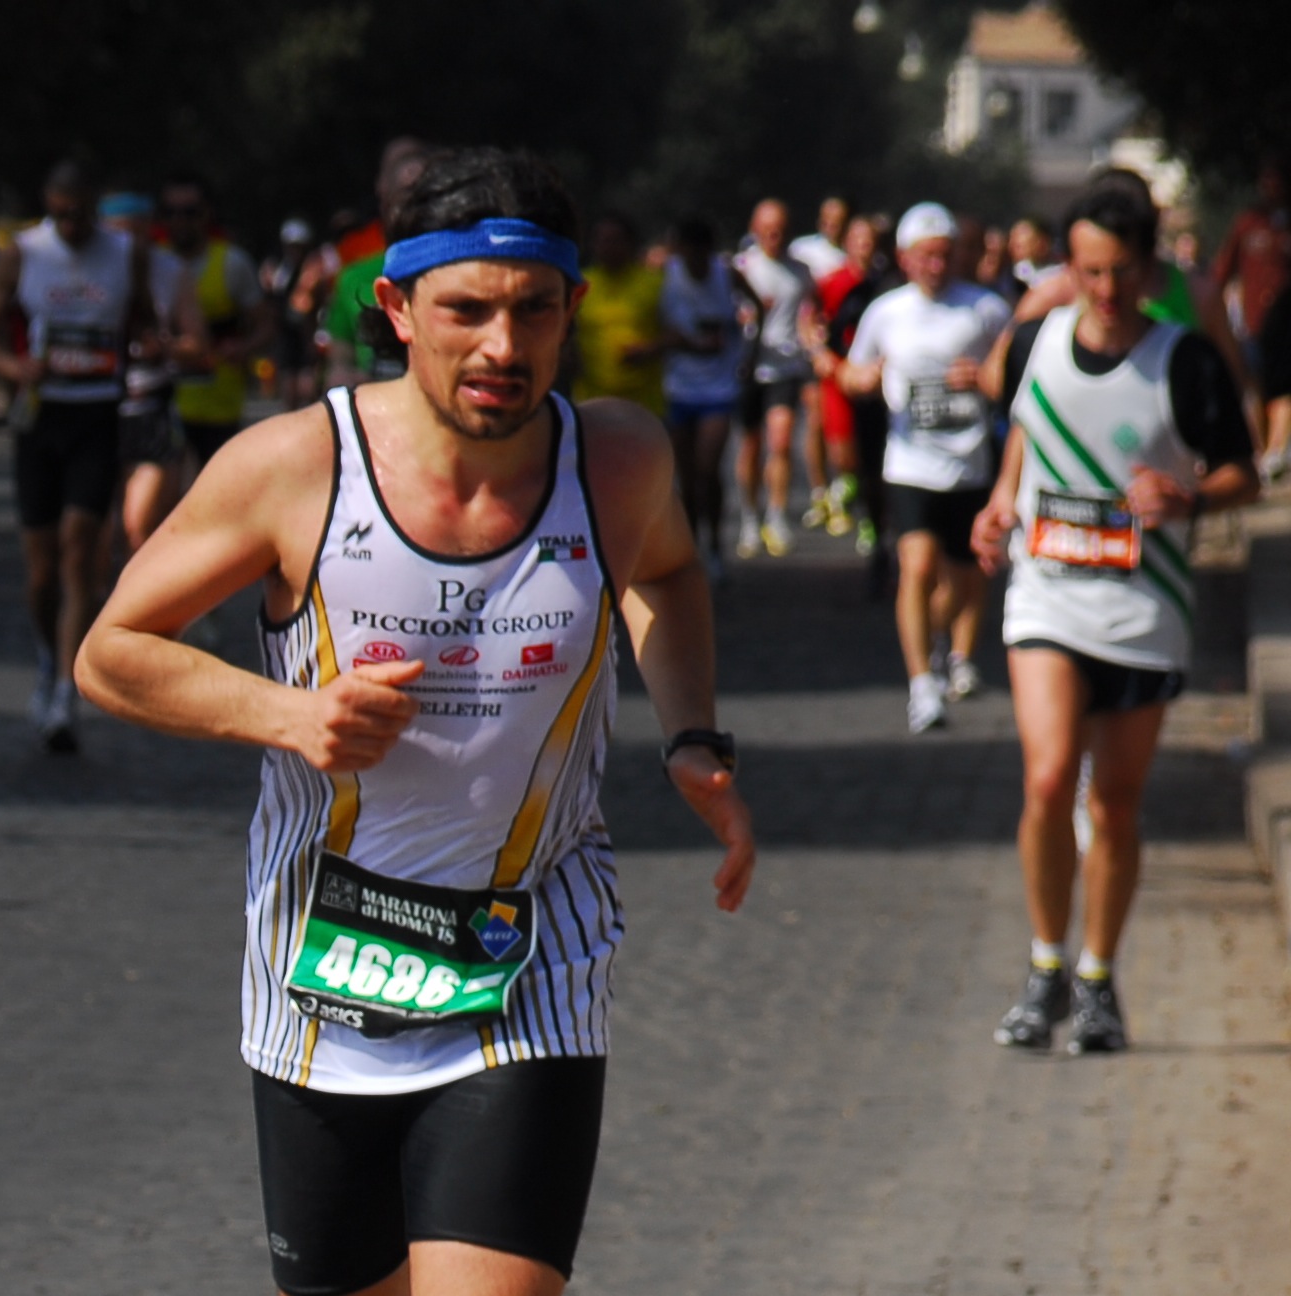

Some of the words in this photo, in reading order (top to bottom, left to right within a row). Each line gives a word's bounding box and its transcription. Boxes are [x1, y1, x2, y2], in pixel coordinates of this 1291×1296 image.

[537, 535, 586, 548] ITALIA
[351, 610, 487, 637] PICCIONI
[492, 611, 574, 635] GROUP
[371, 646, 400, 660] KIA
[502, 664, 568, 682] DAIHATSU
[420, 701, 502, 718] ELLETRI
[361, 887, 458, 926] MARATONA
[381, 908, 433, 937] ROMA
[315, 934, 461, 1008] 4686
